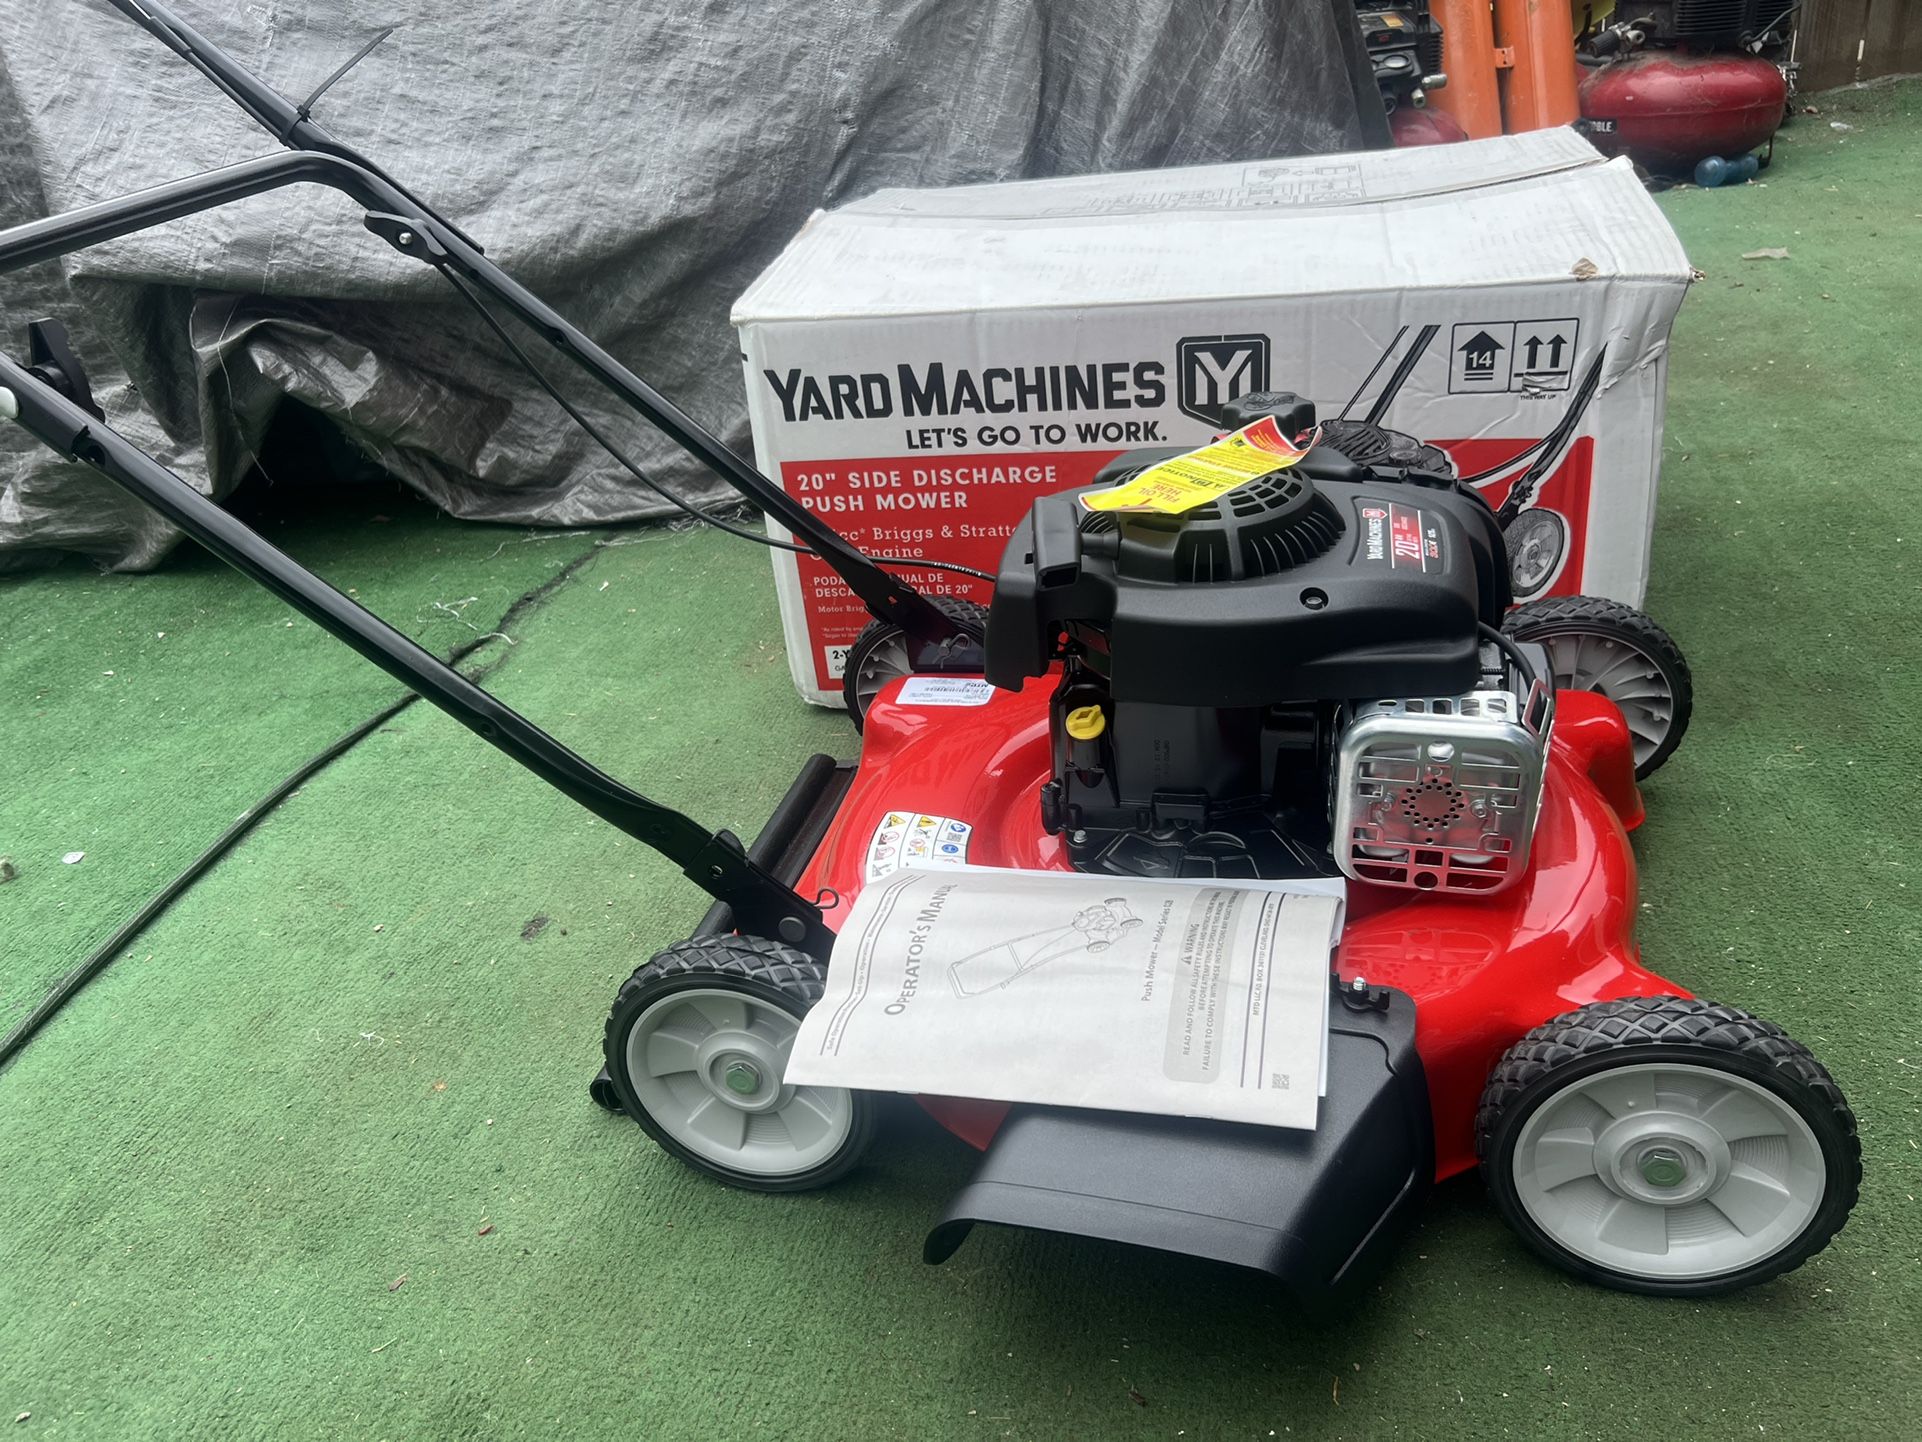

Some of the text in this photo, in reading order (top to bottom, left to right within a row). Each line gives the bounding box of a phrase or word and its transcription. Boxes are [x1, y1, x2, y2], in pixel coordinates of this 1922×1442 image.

[1469, 351, 1493, 368] 14
[763, 360, 1167, 422] YARD MACHINES
[905, 420, 1168, 450] LET'S GO TO WORK.
[796, 465, 1057, 492] 20" SIDE DISCHARGE
[1139, 487, 1181, 503] FILL OIL
[1152, 483, 1182, 496] HERE
[801, 491, 969, 513] PUSH MOWER
[872, 526, 934, 543] Briggs
[940, 524, 954, 539] &
[857, 545, 924, 558] Engine
[813, 576, 848, 587] PODA
[927, 573, 944, 584] DE
[815, 587, 857, 598] DESCA
[936, 584, 952, 595] DE
[818, 604, 866, 614] Motor Brig
[832, 649, 851, 660] 2-Y
[1158, 908, 1172, 926] Series
[1151, 925, 1166, 943] Model
[1184, 923, 1200, 954] WARNING
[883, 924, 932, 1016] OPERATOR'S
[1145, 951, 1158, 980] Mower
[1192, 957, 1201, 978] SAFETY
[1141, 981, 1154, 1002] Push
[1197, 986, 1208, 1011] BEFORE
[1209, 983, 1218, 998] WITH
[1186, 990, 1197, 1017] FOLLOW
[1252, 1002, 1262, 1016] MTD
[1206, 1000, 1216, 1027] COMPLY
[1184, 1018, 1194, 1034] AND
[1204, 1029, 1213, 1039] TO
[1182, 1035, 1192, 1056] READ
[1201, 1041, 1213, 1071] FAILURE
